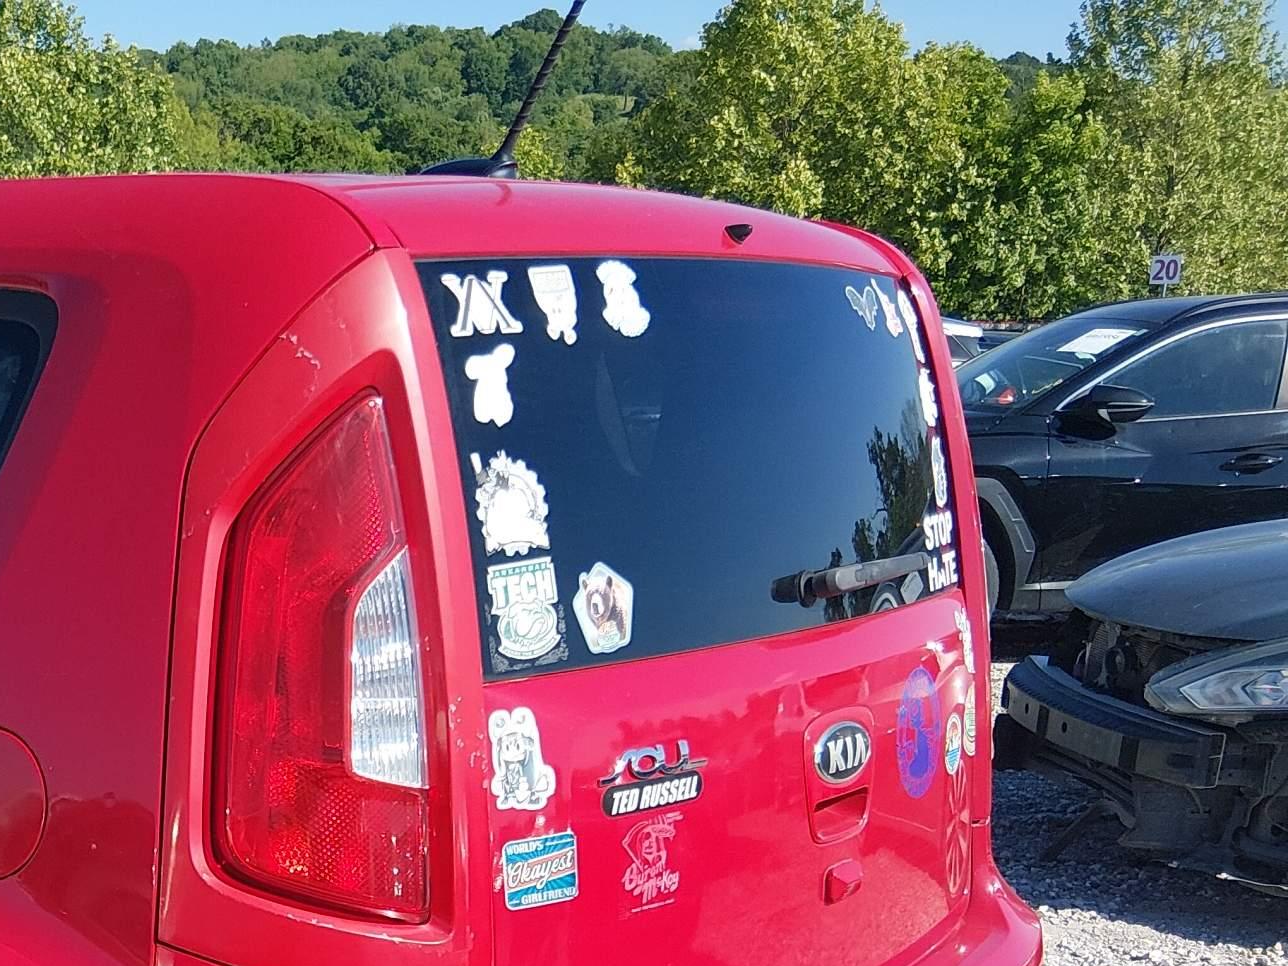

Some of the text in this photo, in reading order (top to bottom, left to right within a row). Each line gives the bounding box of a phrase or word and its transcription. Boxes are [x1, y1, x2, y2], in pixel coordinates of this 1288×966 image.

[1152, 259, 1179, 281] 20
[923, 511, 953, 550] STOP
[491, 568, 555, 610] TECH
[927, 550, 959, 592] HATE
[826, 733, 866, 774] KIA
[611, 775, 699, 816] TED RUSSELL
[507, 850, 574, 890] Okayest
[520, 886, 576, 905] GIRLFRIEND
